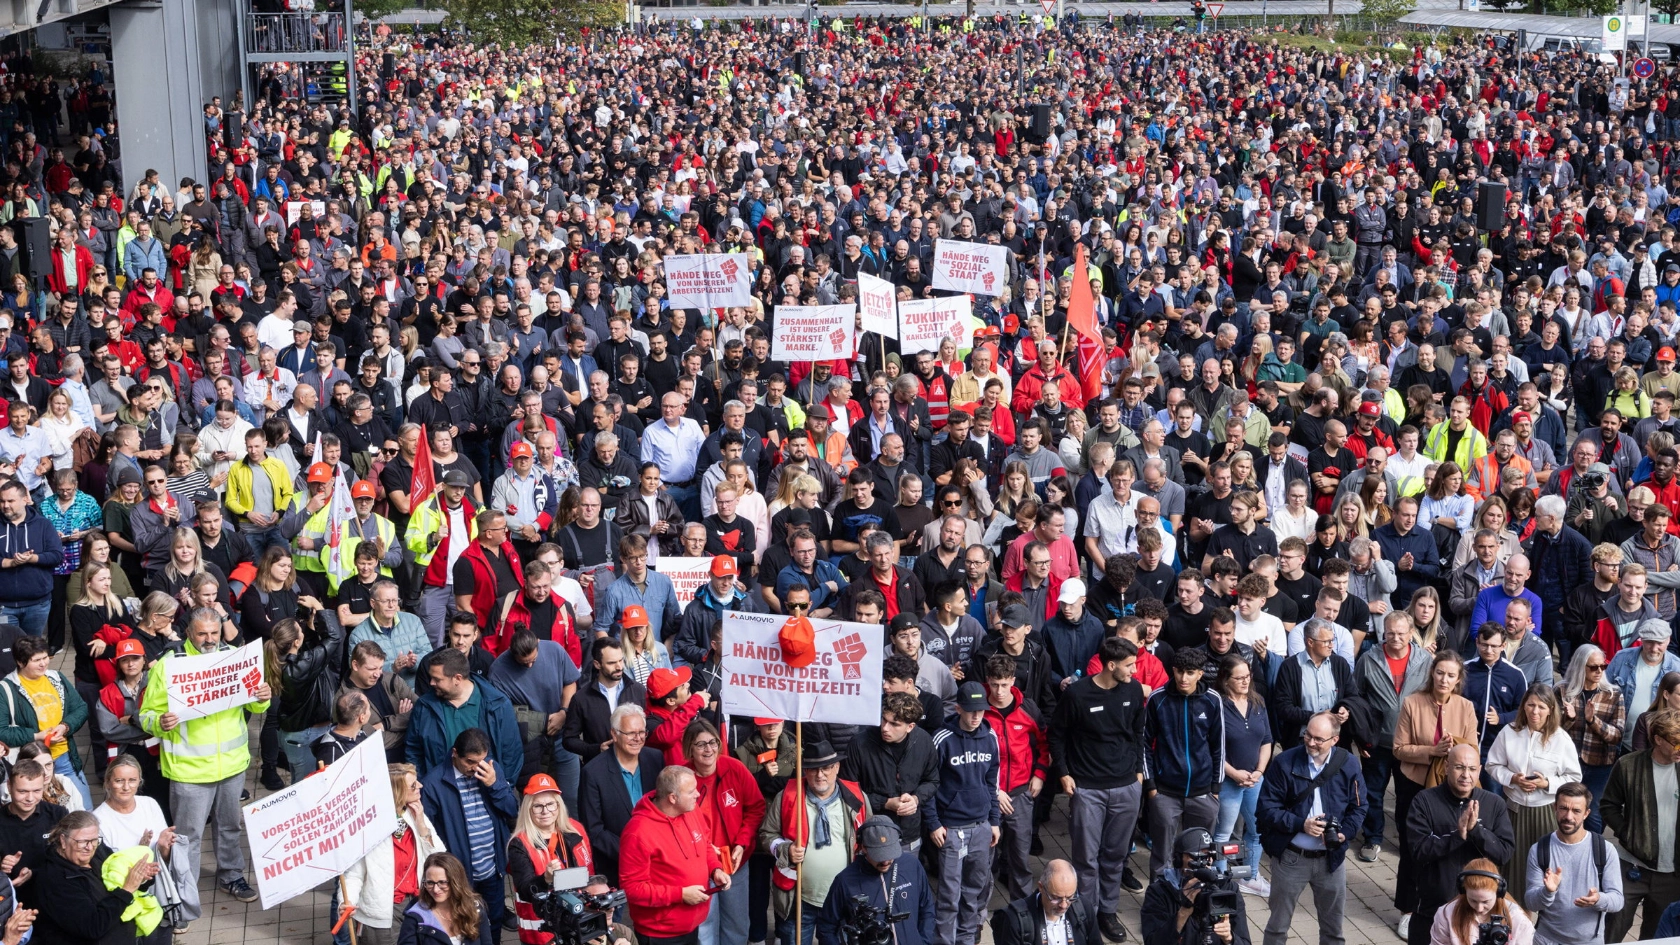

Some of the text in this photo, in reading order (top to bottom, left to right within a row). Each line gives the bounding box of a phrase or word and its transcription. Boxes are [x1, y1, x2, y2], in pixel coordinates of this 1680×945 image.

[942, 250, 989, 264] HÄNDE WEG
[949, 270, 978, 280] STAAT
[951, 261, 986, 272] SOZIAL-
[670, 271, 700, 280] HÄNDE
[863, 291, 884, 310] JETZT
[780, 317, 843, 325] ZUSAMMENHALT
[905, 310, 957, 325] ZUKUNFT
[906, 331, 950, 340] KAHLSCHLAG!
[918, 323, 944, 333] STATT
[780, 333, 822, 342] STÄRKSTE
[739, 614, 774, 623] AUMOVIO
[733, 641, 832, 666] HÄND EG
[172, 656, 258, 684] ZUSAMMENHALT
[764, 663, 829, 679] VON DER
[181, 673, 238, 694] IST UNSERE
[730, 673, 860, 696] ALTERSTEILZEIT!
[187, 684, 240, 707] STÄRKE!
[261, 790, 296, 810] AUMOVIO
[262, 775, 368, 840] VORSTÄNDE VERSAGEN,
[290, 794, 358, 838] BESCHÄFTIGTE
[284, 806, 357, 852] SOLLEN ZAHLEN?
[263, 805, 377, 880] NICHT MIT UNS!
